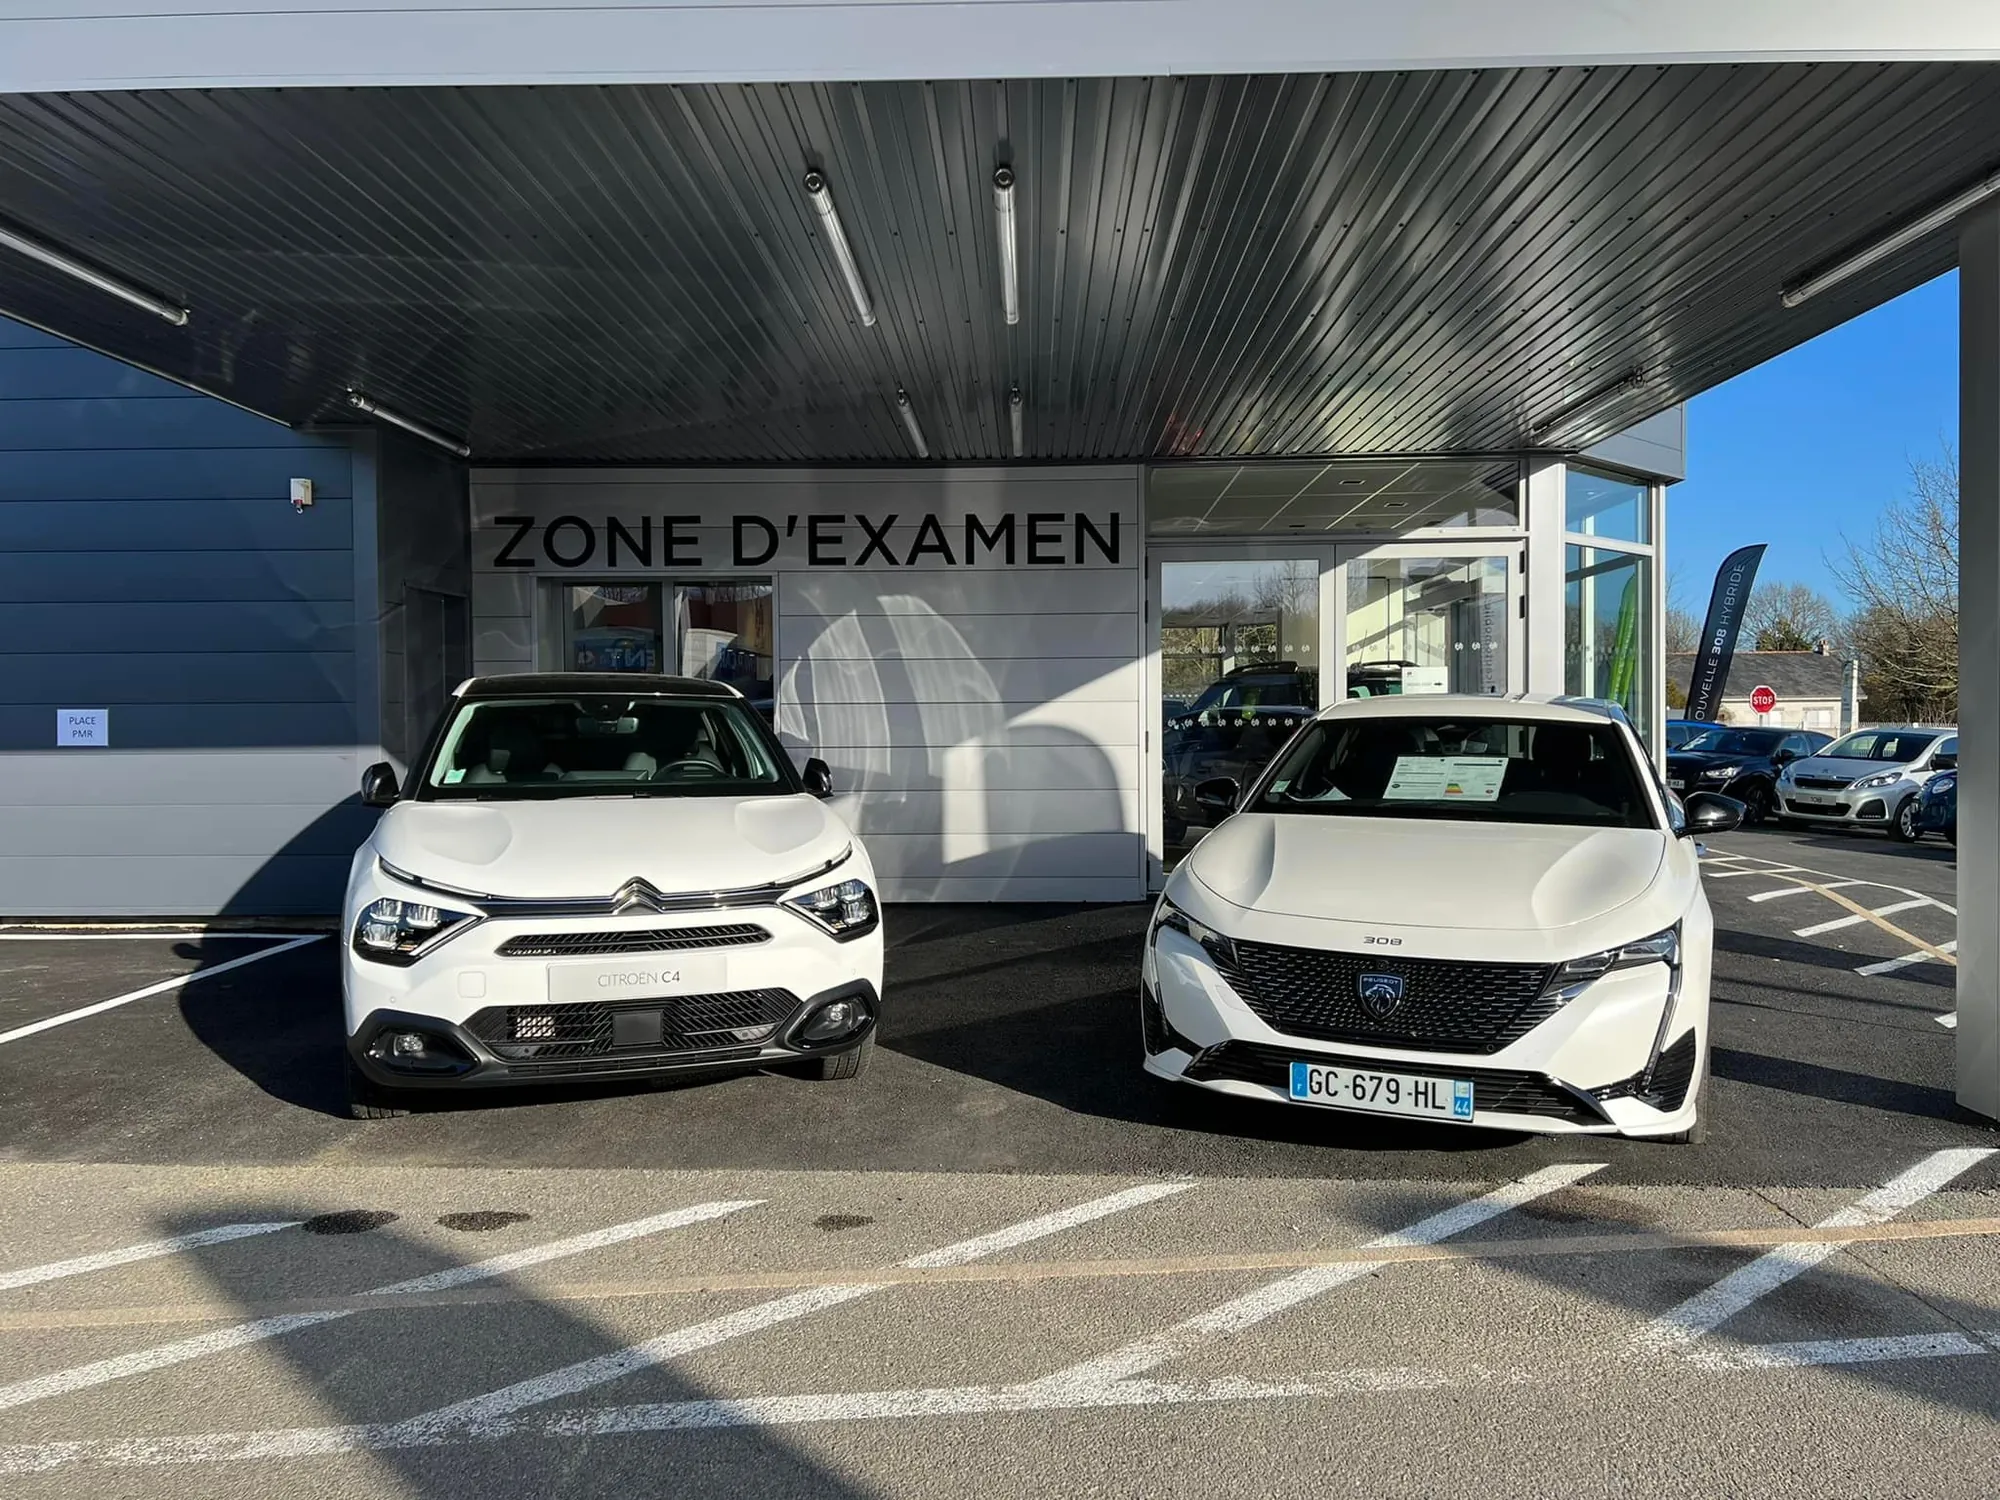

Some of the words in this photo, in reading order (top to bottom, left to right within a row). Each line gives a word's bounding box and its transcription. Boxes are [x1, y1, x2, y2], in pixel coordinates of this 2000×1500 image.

[493, 515, 702, 567] ZONE
[732, 512, 1120, 566] D'EXAMEN
[1695, 658, 1720, 721] OUVELLE
[1712, 628, 1727, 655] 308
[1720, 563, 1746, 626] HYBRIDE
[1753, 695, 1773, 705] STOP
[69, 716, 96, 725] PLACE
[72, 729, 93, 738] PMR
[1363, 936, 1402, 946] 308
[661, 970, 681, 984] C4
[1363, 977, 1399, 985] PEUGEOT
[1297, 1083, 1302, 1091] F
[1454, 1100, 1470, 1114] 44
